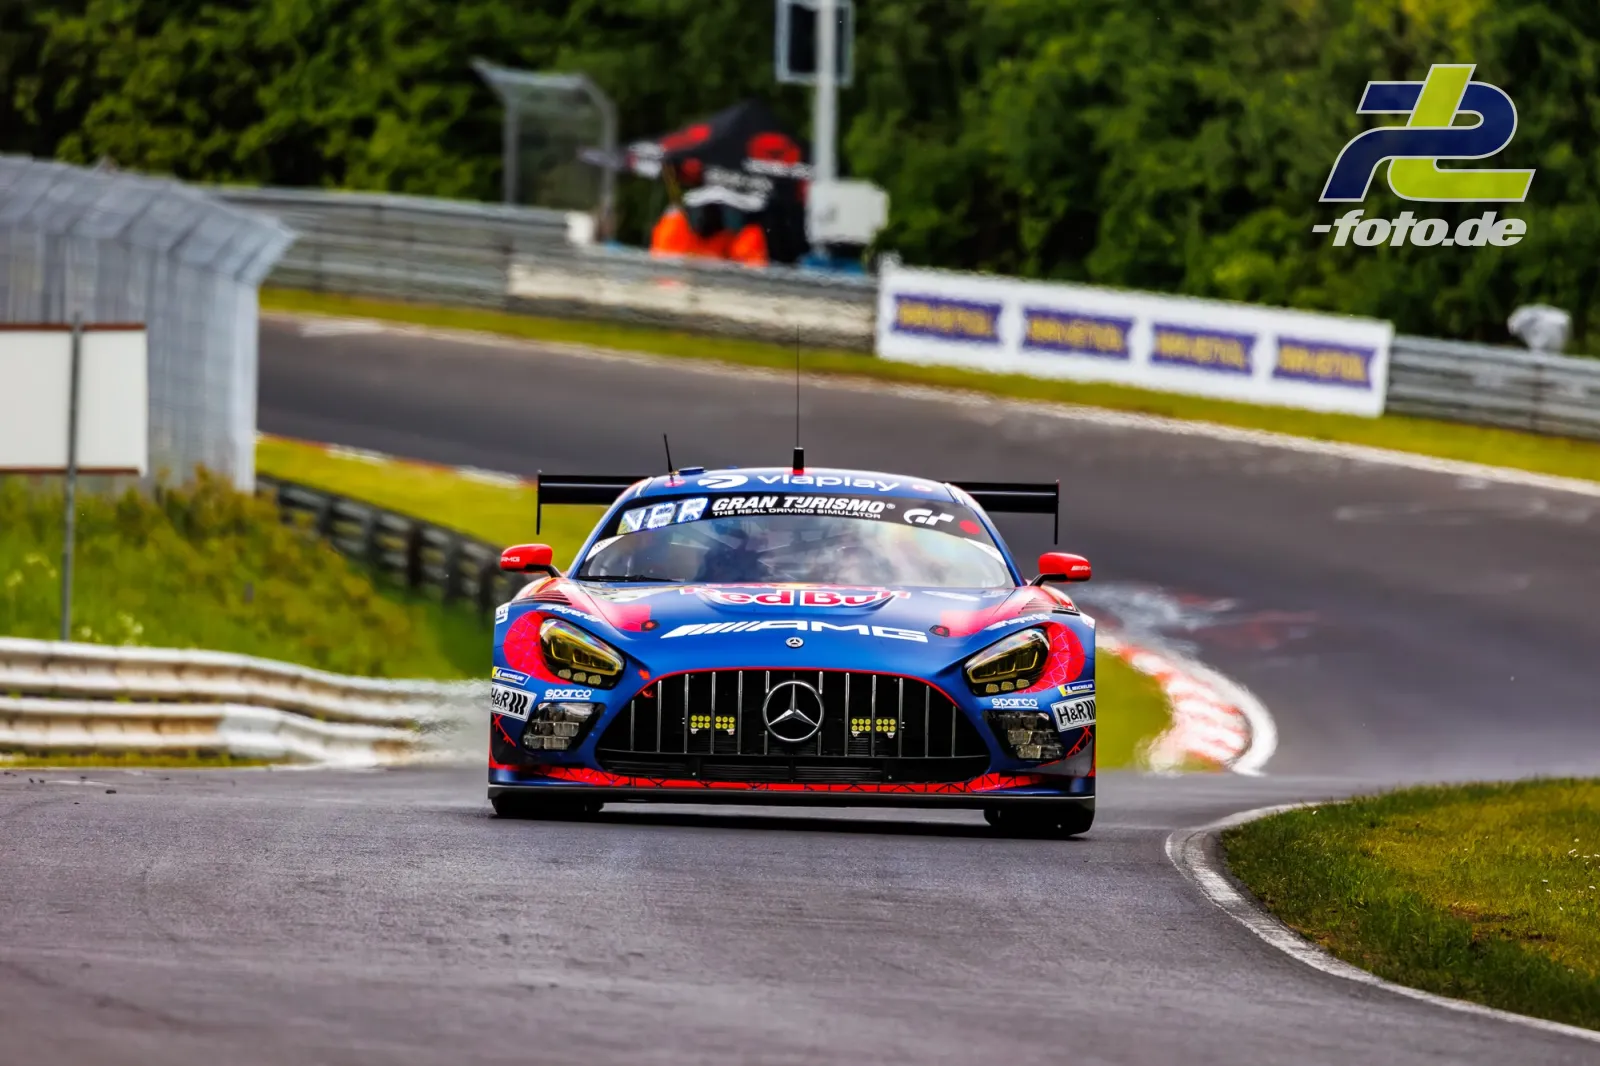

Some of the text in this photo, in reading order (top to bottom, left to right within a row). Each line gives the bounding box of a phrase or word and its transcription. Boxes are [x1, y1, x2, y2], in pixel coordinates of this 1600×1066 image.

[711, 496, 778, 511] GRAN
[816, 508, 881, 519] SIMULATOR
[744, 620, 929, 643] AMG
[545, 688, 592, 700] sparco
[991, 698, 1037, 709] sparco
[1056, 703, 1086, 725] H&R
